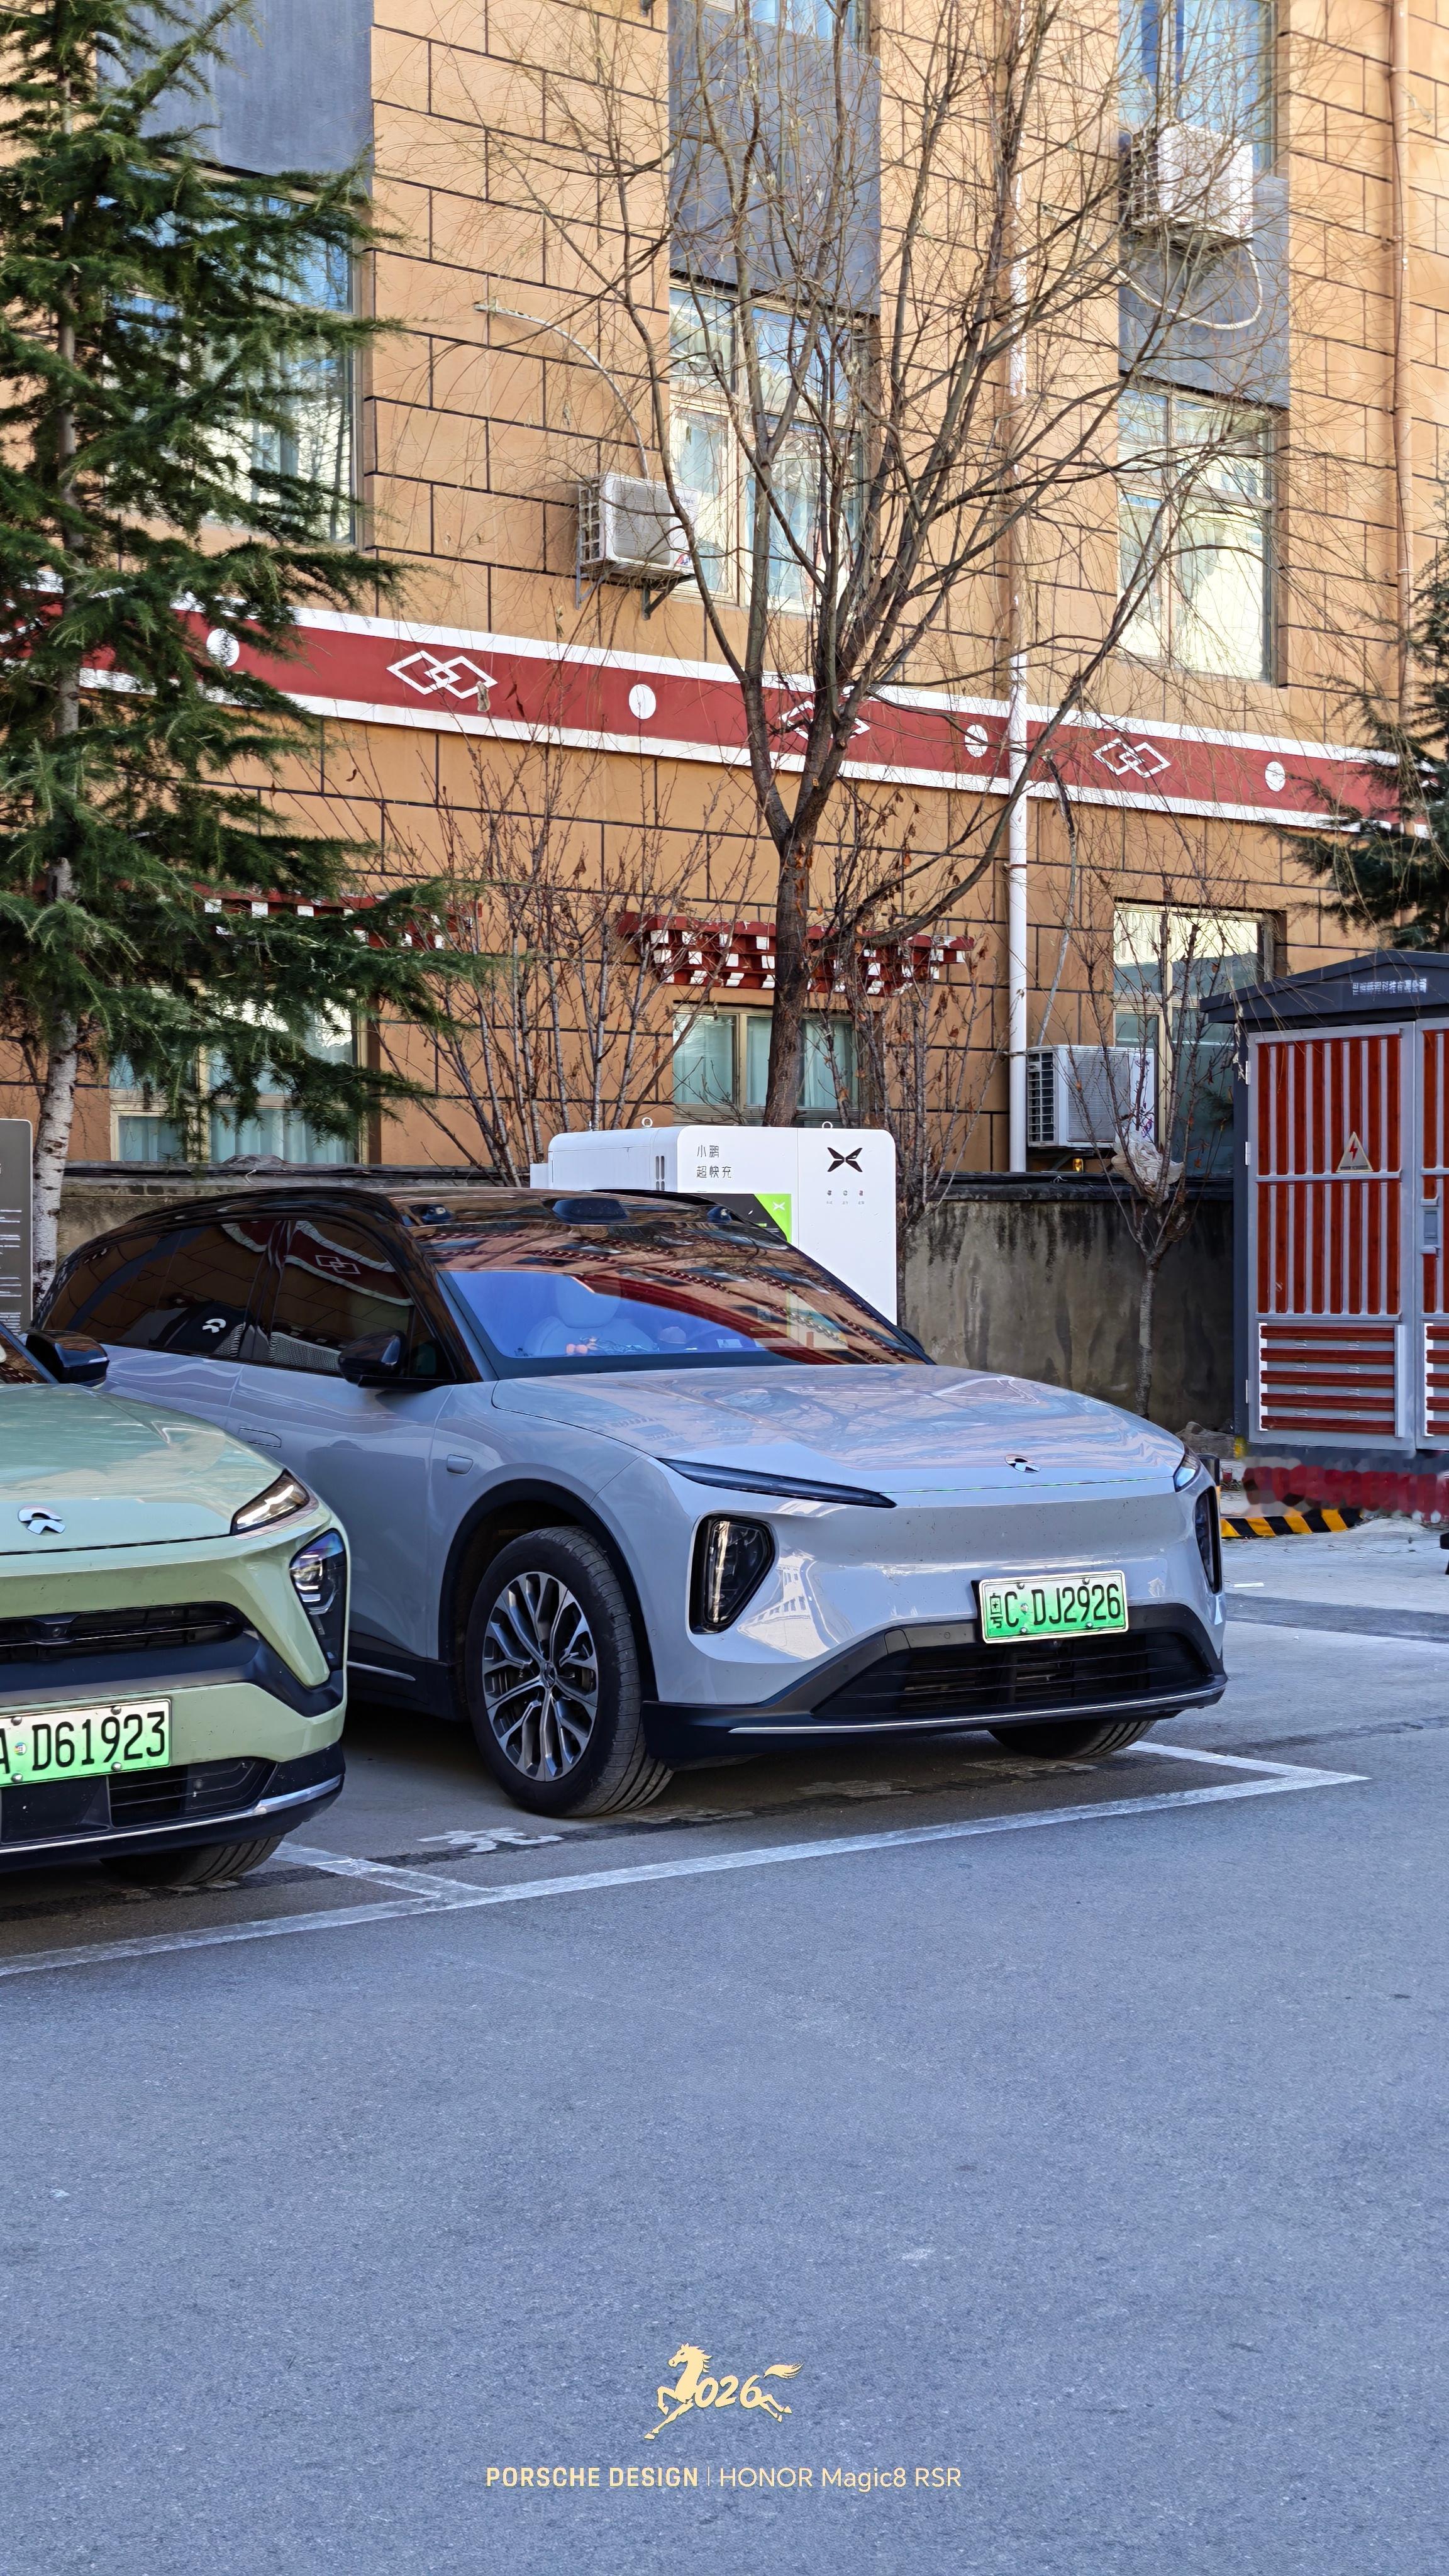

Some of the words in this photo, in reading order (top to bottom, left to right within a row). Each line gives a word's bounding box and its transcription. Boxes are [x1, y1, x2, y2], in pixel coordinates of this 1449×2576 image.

[696, 1144, 719, 1158] 小鹏
[696, 1165, 732, 1179] 超快充
[1031, 1583, 1121, 1626] DJ2926
[31, 1711, 165, 1771] D61923
